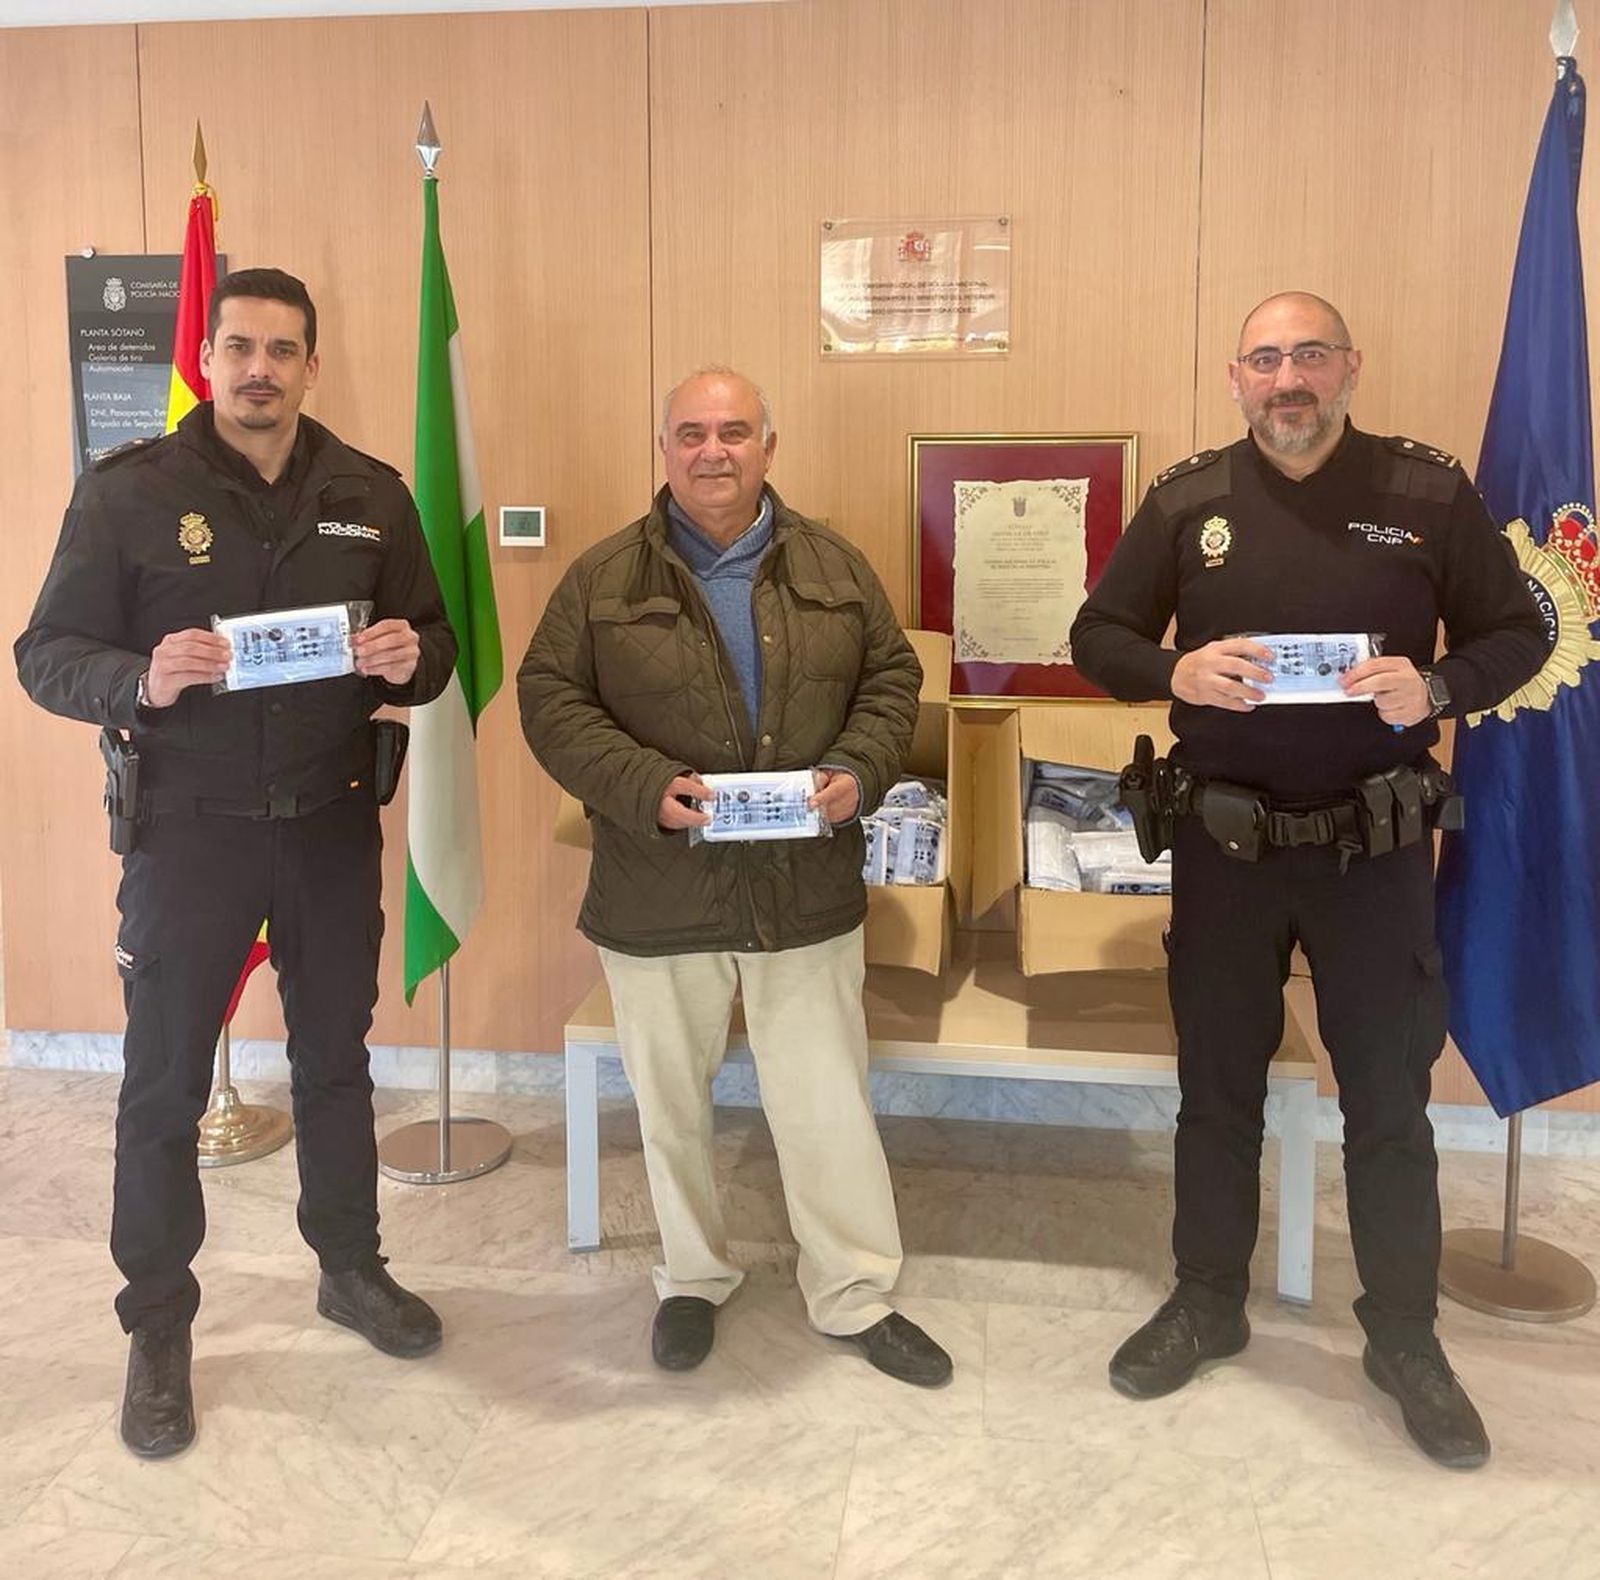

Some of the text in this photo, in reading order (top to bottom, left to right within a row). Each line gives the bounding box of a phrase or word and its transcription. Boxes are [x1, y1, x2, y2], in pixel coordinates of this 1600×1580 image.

[158, 290, 182, 298] NACIO
[80, 329, 110, 337] PLANTA
[107, 343, 118, 351] de
[118, 354, 129, 362] de
[83, 393, 132, 401] PLANTA BAJA
[122, 420, 132, 428] de
[1348, 522, 1413, 540] POLICIA
[1367, 533, 1403, 545] CNP
